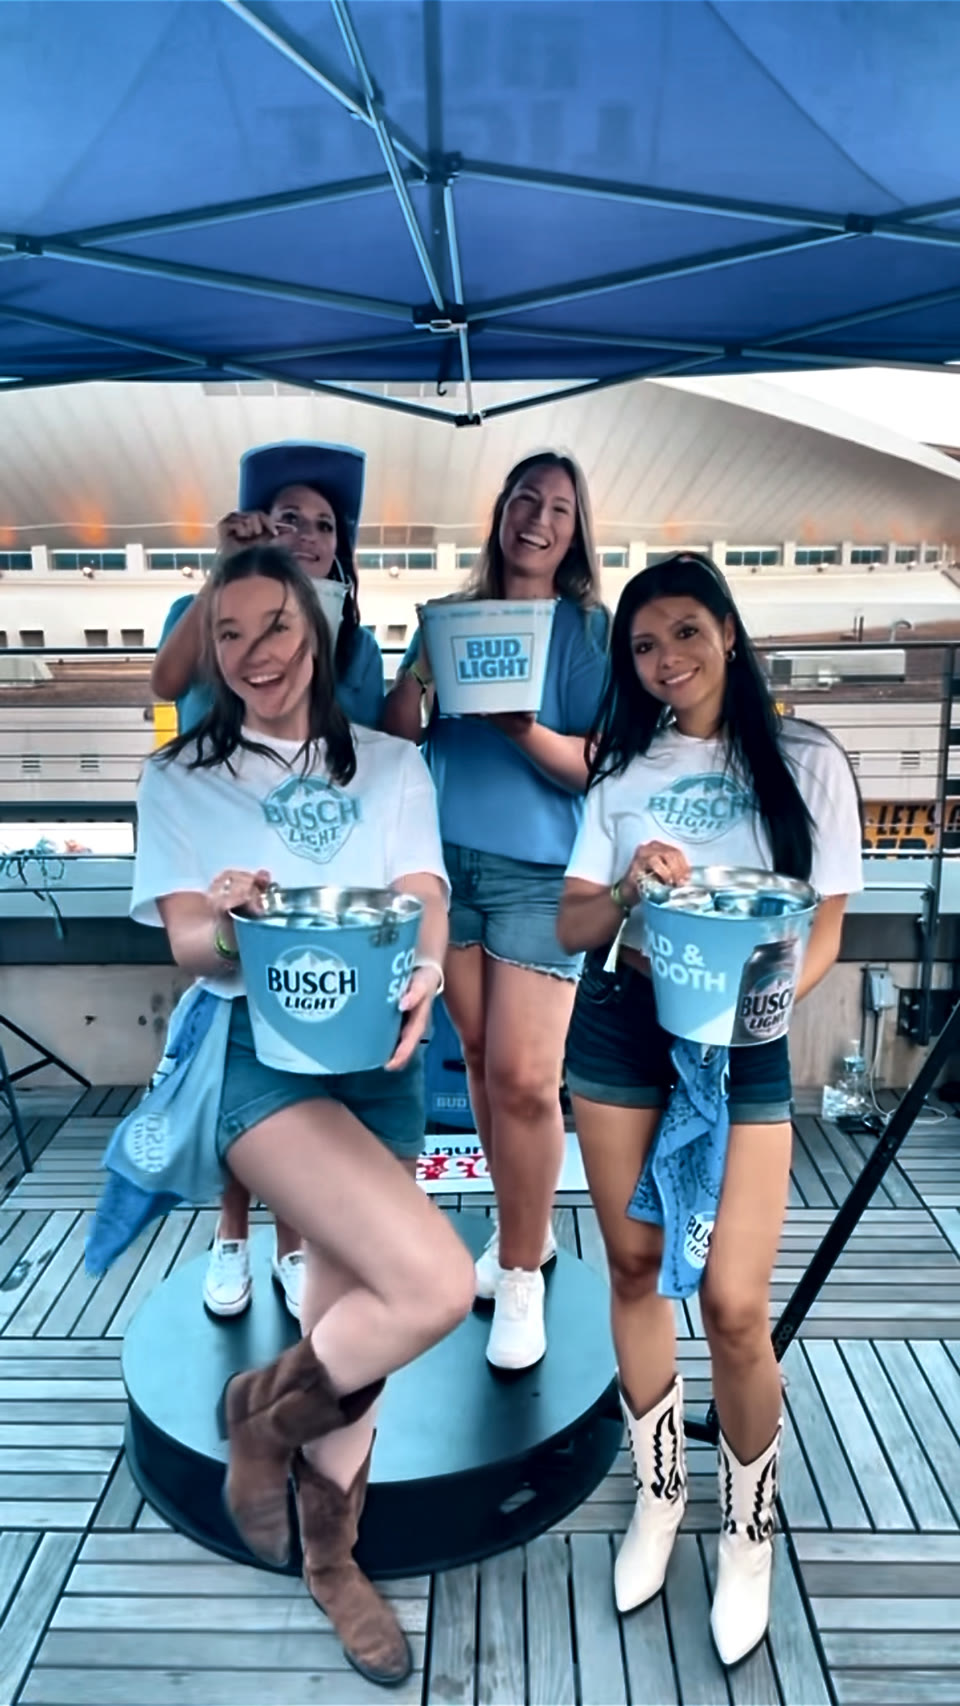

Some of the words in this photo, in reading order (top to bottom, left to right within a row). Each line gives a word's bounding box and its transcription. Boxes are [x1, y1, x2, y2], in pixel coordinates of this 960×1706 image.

[466, 638, 521, 659] BUD
[459, 657, 528, 679] LIGHT
[260, 798, 360, 831] BUSCH
[289, 826, 340, 847] LIGHT
[683, 944, 704, 967] &
[267, 967, 357, 995] BUSCH
[285, 996, 337, 1010] LIGHT
[436, 1097, 467, 1108] BUD
